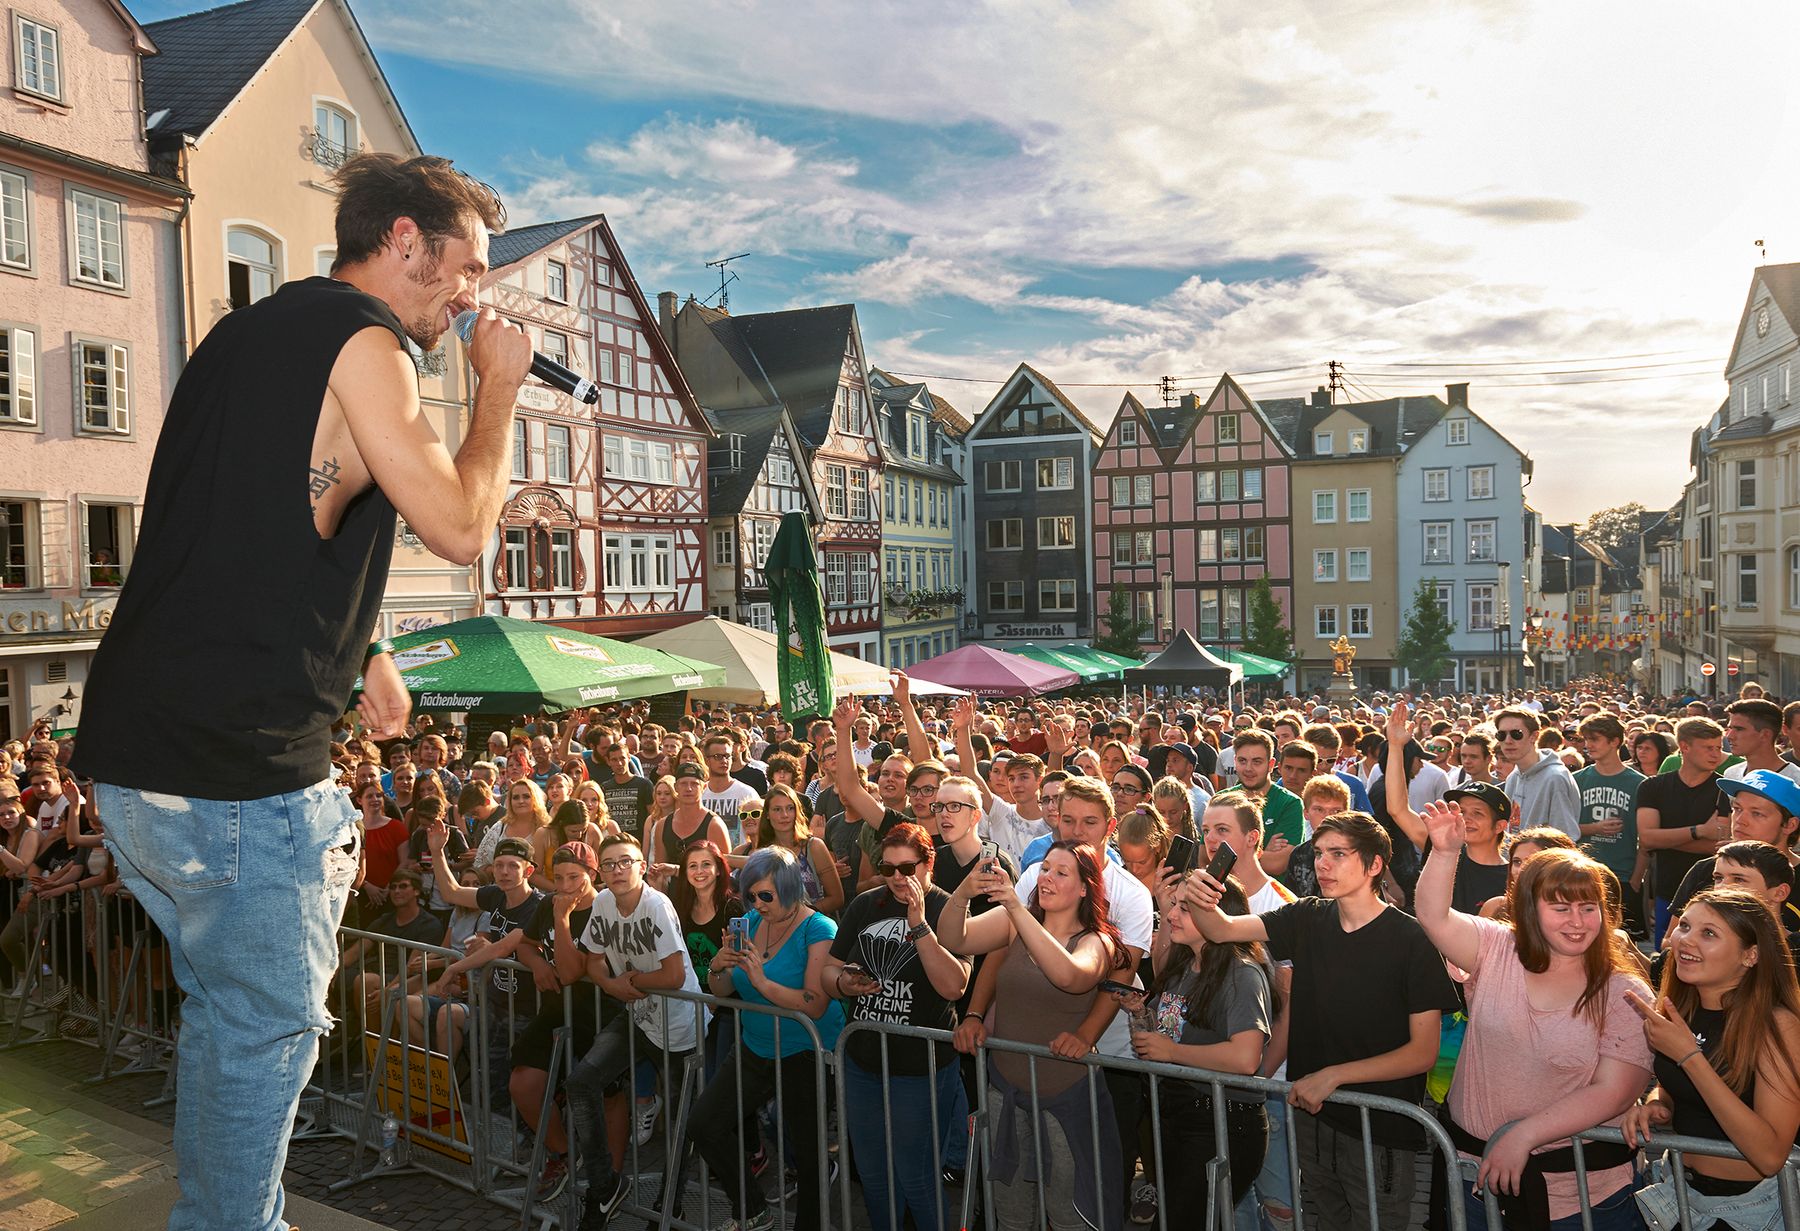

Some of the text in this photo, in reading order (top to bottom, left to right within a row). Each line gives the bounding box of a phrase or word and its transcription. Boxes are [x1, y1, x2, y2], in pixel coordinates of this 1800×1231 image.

[994, 624, 1065, 637] Sassenrath
[1583, 786, 1631, 812] HERITAGE
[873, 996, 913, 1013] KEINE
